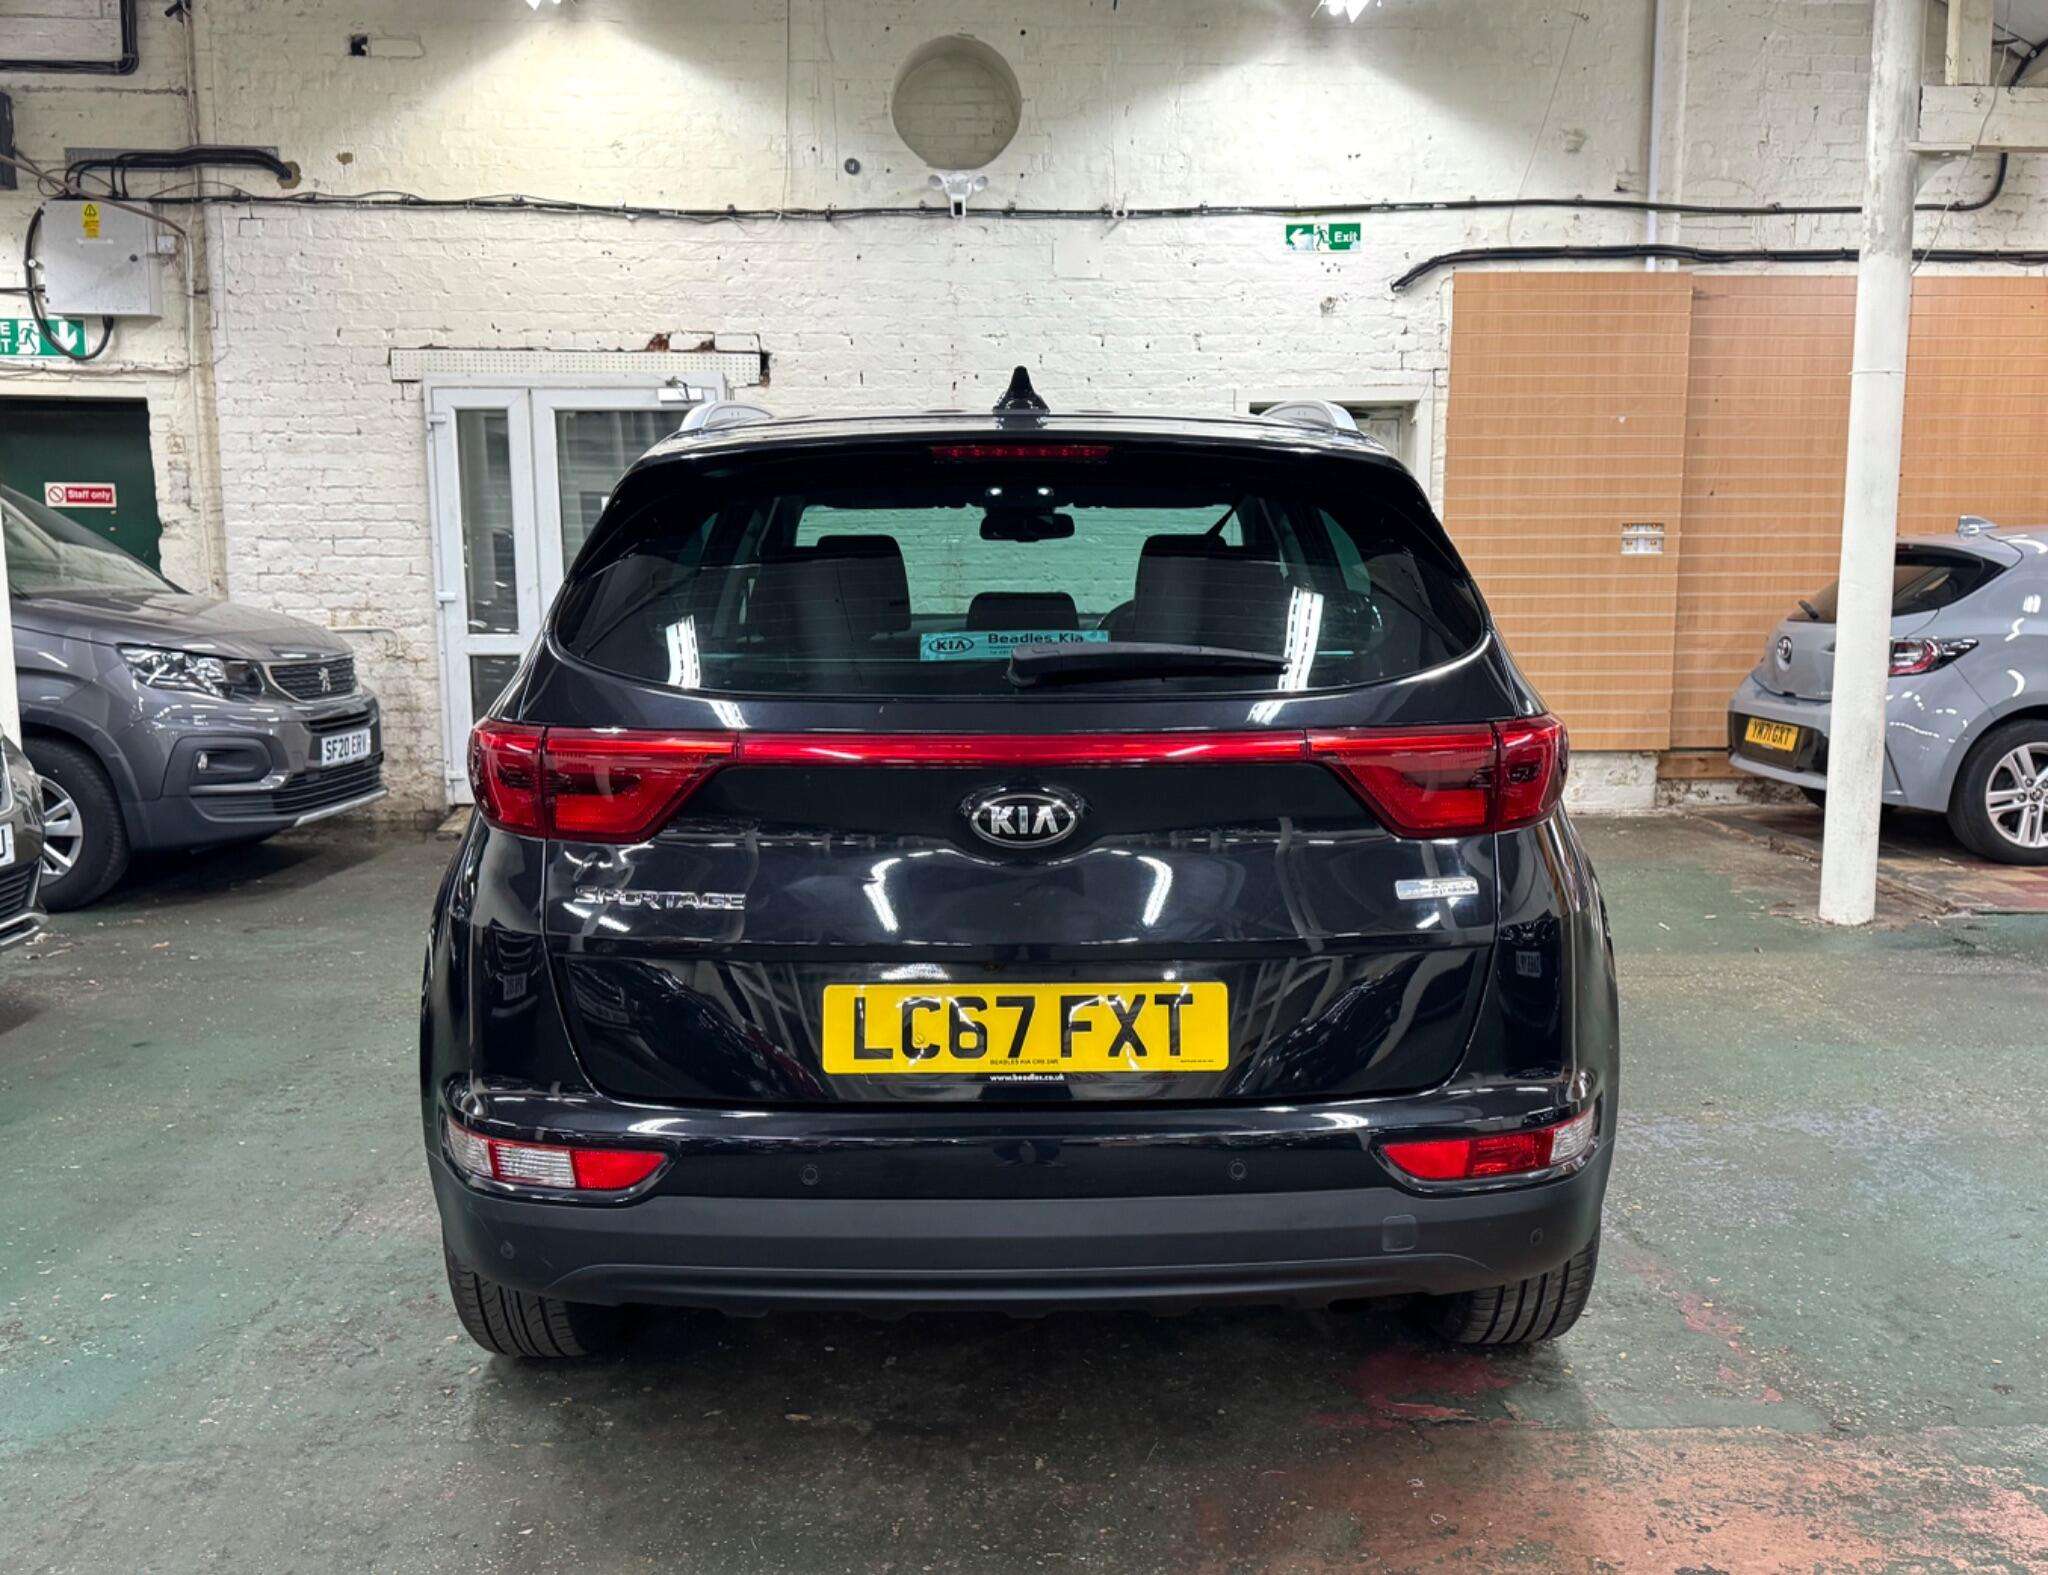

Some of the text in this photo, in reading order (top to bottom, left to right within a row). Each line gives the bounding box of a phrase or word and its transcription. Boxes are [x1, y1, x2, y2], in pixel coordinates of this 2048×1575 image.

[1334, 231, 1358, 242] Exit
[67, 489, 110, 502] Staff only
[936, 640, 967, 651] KIA
[988, 632, 1084, 644] Beadles Kia
[326, 737, 350, 760] SF20
[990, 805, 1059, 835] KIA
[574, 886, 746, 910] SPORTAGE
[854, 993, 1194, 1060] LC67 FXT
